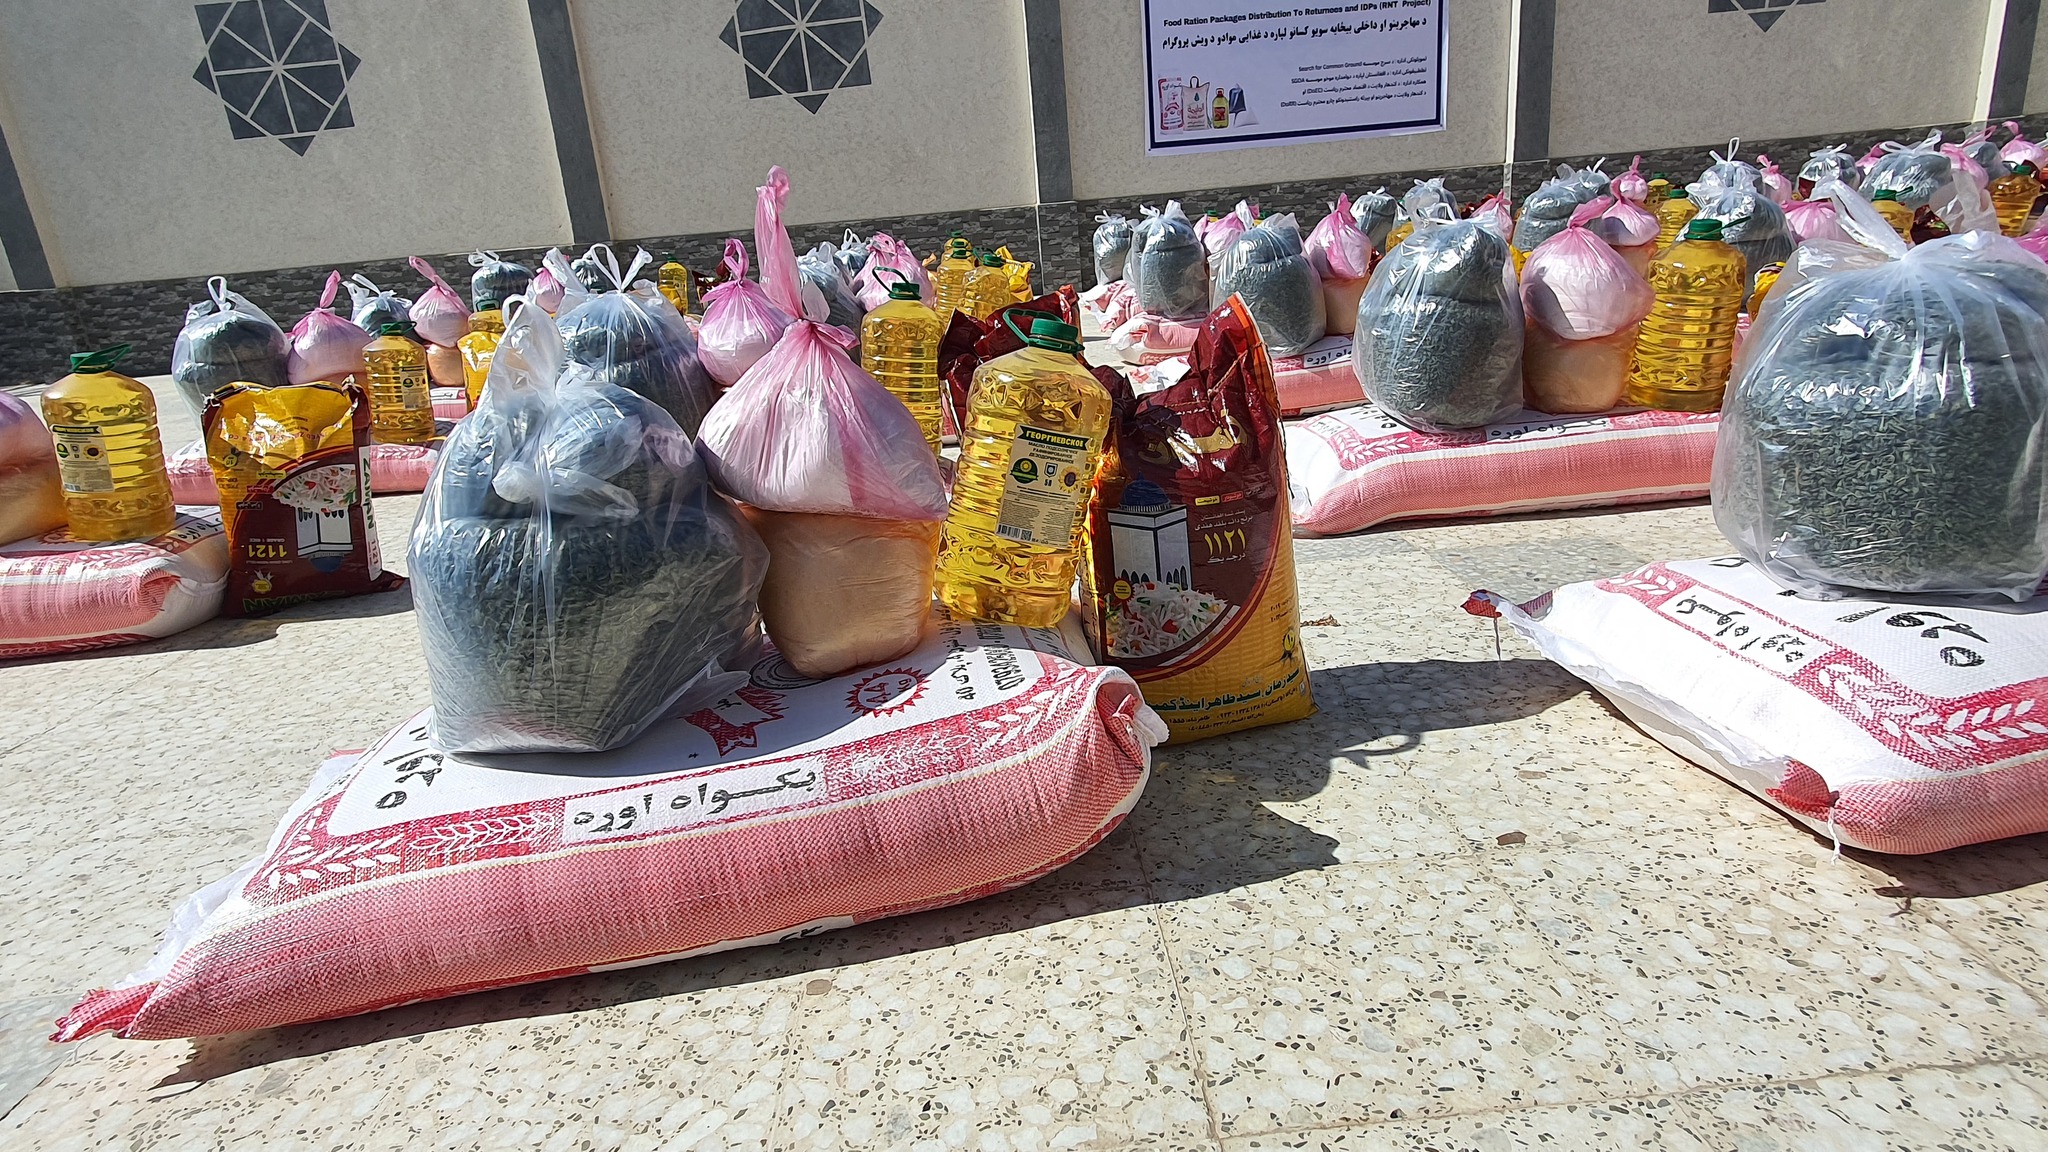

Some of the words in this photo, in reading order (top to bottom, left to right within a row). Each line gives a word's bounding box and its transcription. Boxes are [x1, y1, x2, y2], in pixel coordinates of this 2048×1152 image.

[1163, 18, 1182, 27] Food
[1184, 16, 1208, 26] Ration
[1210, 14, 1246, 24] Packages
[1248, 10, 1292, 20] Distribution
[1293, 9, 1303, 17] To
[1304, 7, 1343, 16] Returnees
[1344, 4, 1358, 12] and
[1360, 3, 1378, 12] IDPs
[1379, 0, 1398, 10] (RNT
[1402, 0, 1431, 8] Project)
[1380, 18, 1387, 32] او
[1210, 35, 1215, 43] د
[1263, 31, 1268, 39] د
[1026, 430, 1084, 448] ГЕОРГИЕВСКОЕ
[1204, 528, 1246, 556] ۱۱۲۱
[248, 544, 288, 558] 1121
